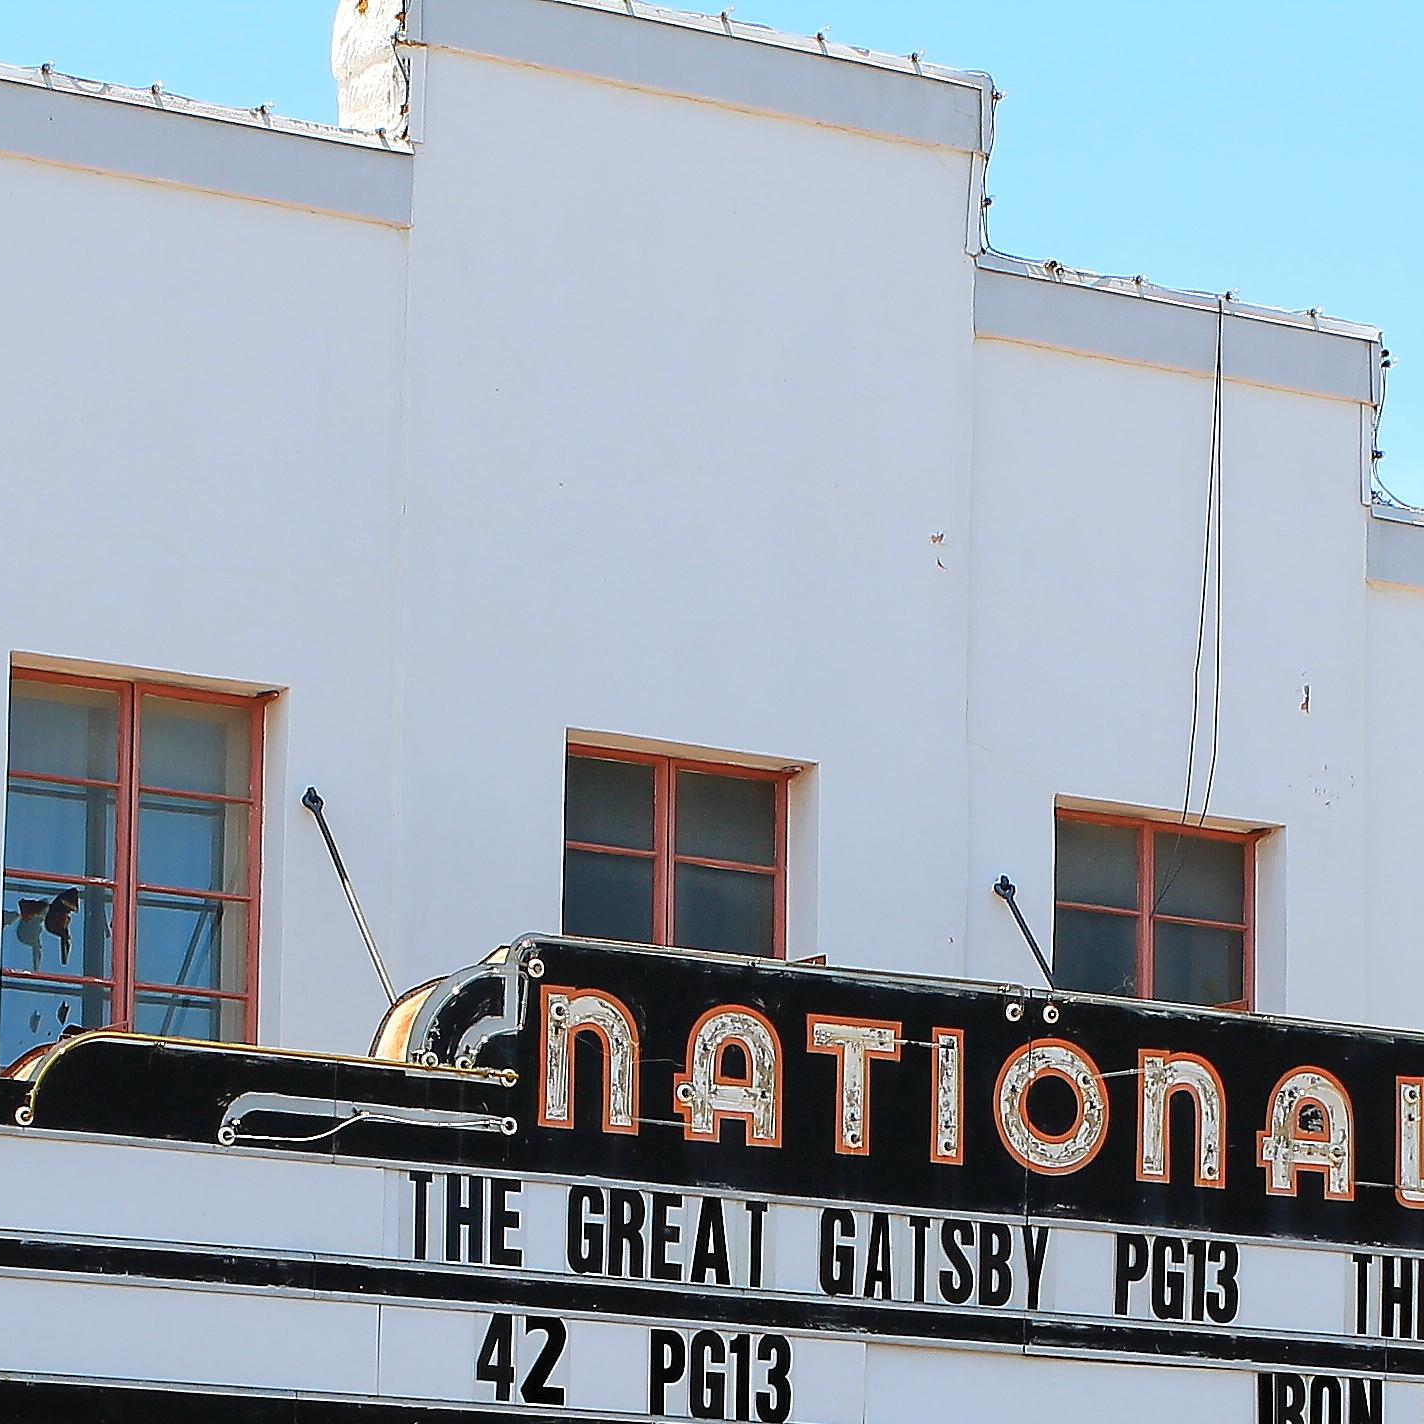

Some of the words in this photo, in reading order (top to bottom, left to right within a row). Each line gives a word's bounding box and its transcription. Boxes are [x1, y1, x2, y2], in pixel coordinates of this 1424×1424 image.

[408, 1171, 522, 1267] THE
[568, 1185, 768, 1288] GREAT
[819, 1207, 1052, 1310] GATSBY
[1114, 1232, 1239, 1324] PG13
[475, 1312, 568, 1406] 42
[649, 1328, 793, 1421] PG13
